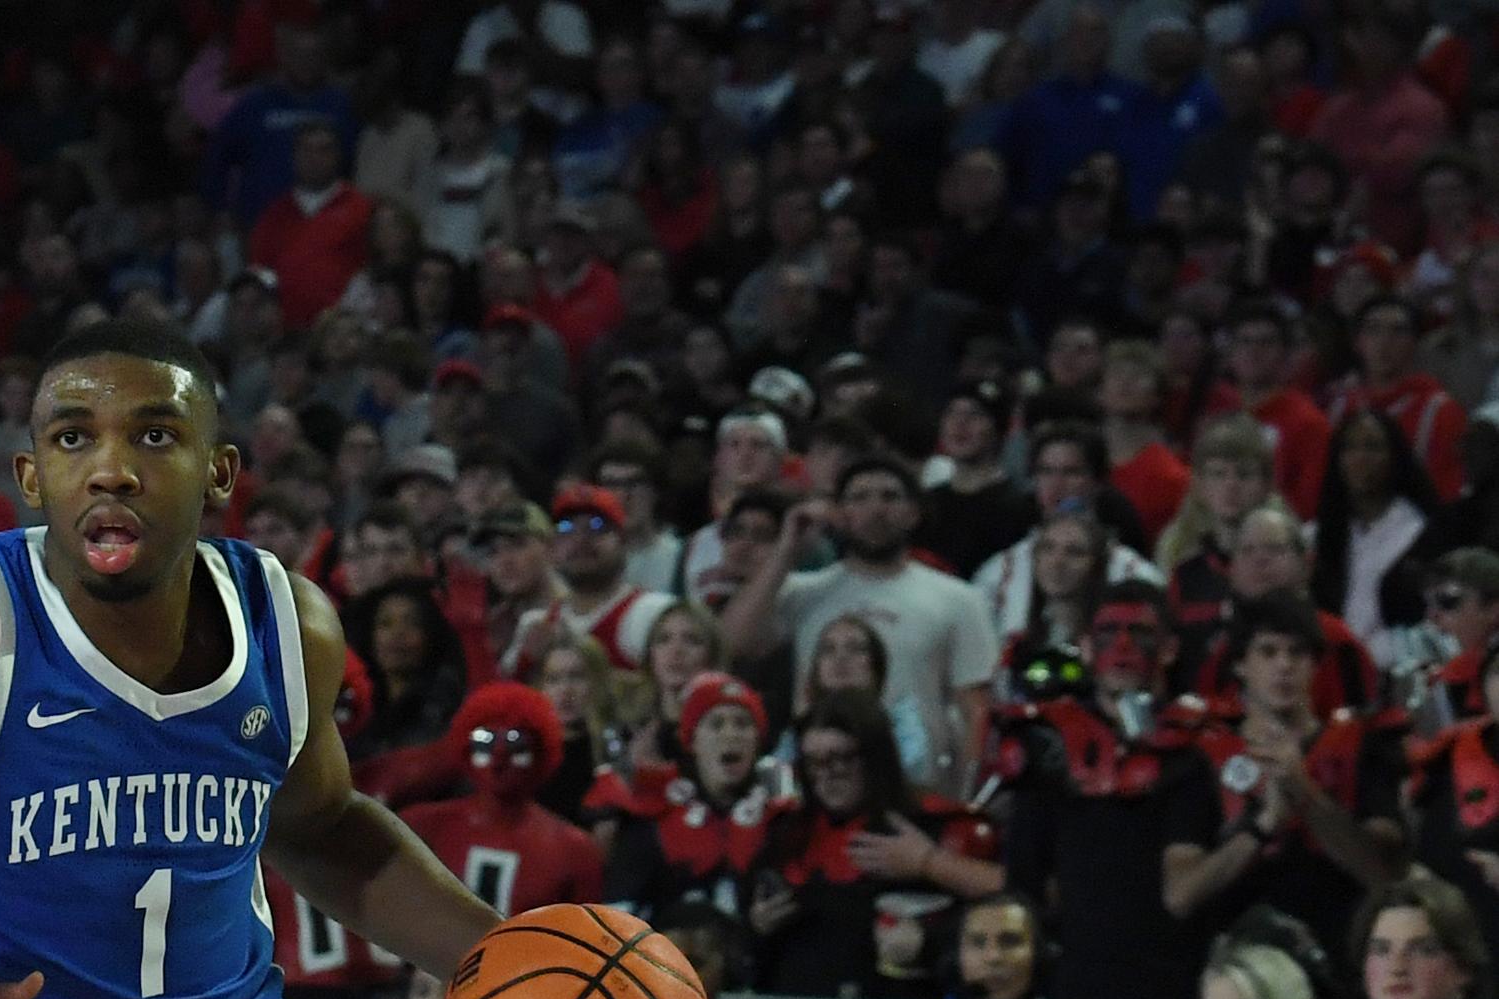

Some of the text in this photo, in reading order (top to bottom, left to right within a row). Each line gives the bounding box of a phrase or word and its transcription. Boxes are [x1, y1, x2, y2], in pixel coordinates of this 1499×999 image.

[242, 707, 268, 737] SEC
[8, 773, 270, 863] KENTUCKY
[135, 868, 172, 999] 1
